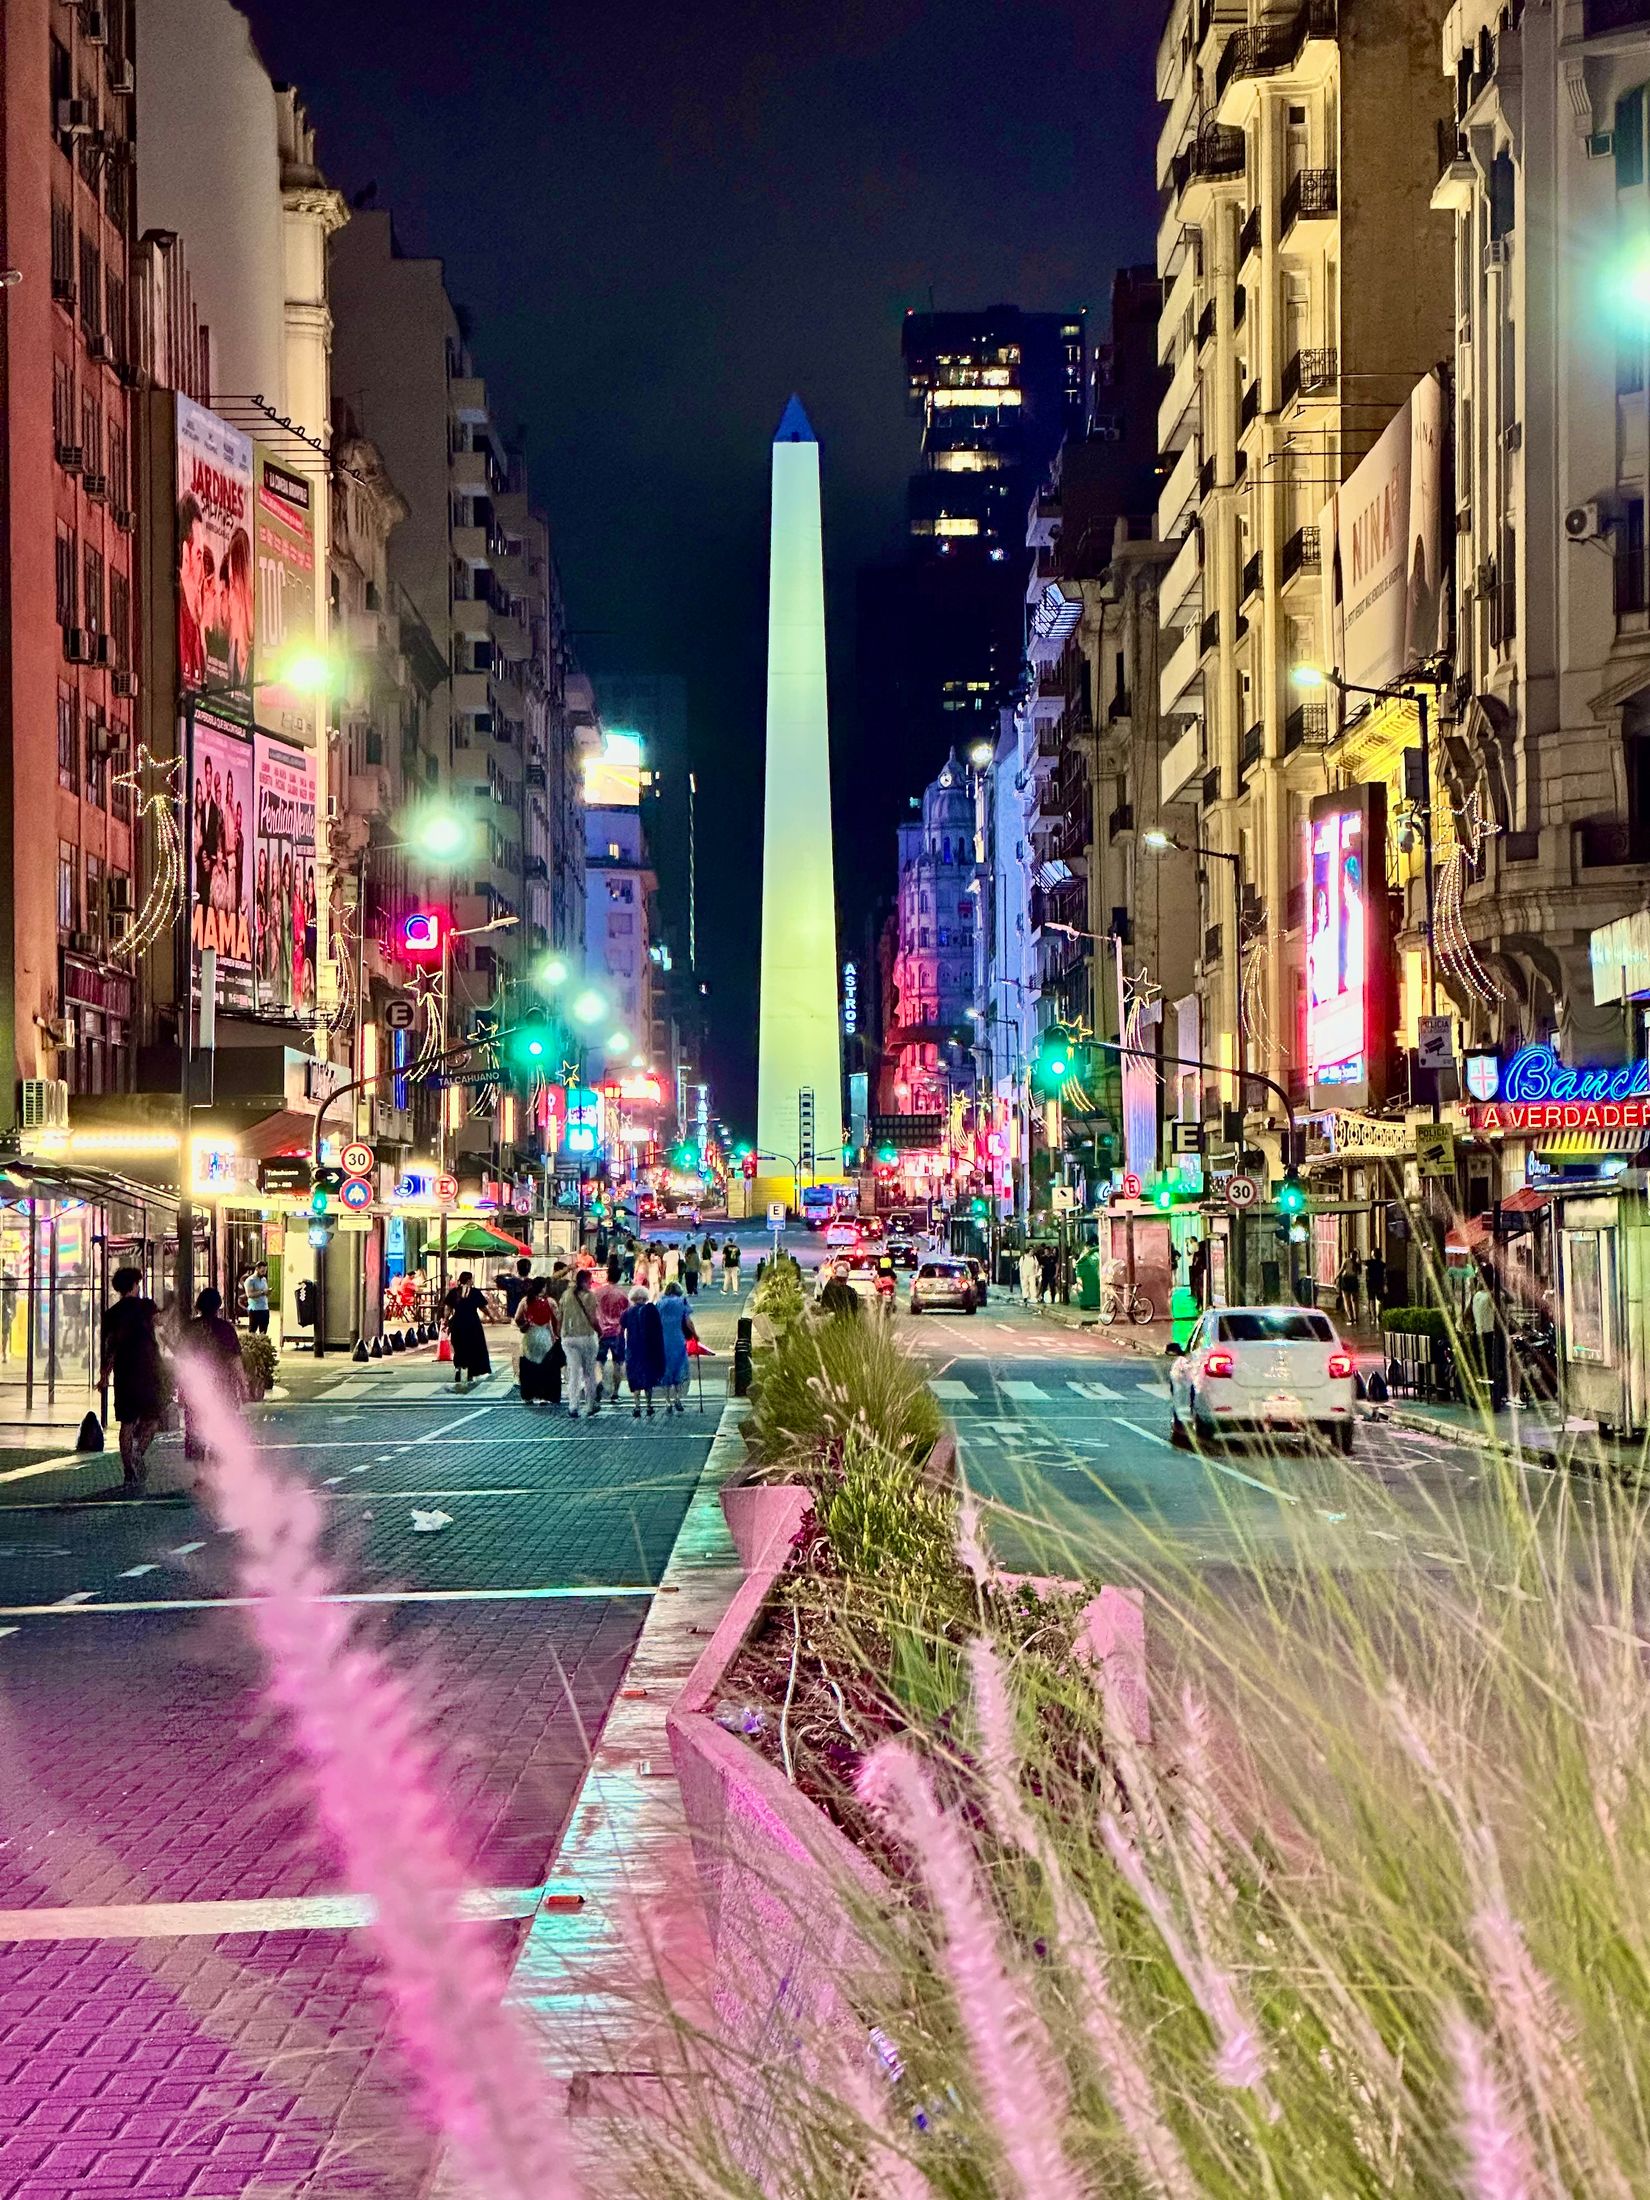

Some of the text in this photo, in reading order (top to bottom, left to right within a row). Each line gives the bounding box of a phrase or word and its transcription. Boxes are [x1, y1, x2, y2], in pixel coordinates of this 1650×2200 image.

[191, 455, 244, 520] JARDINES
[1352, 483, 1393, 588] NINA
[259, 555, 287, 646] TOC
[844, 963, 857, 1034] ASTROS
[391, 1005, 409, 1025] E
[438, 1071, 500, 1087] TALCAHUANO
[1177, 1126, 1199, 1151] E
[348, 1153, 366, 1166] 30
[1129, 1180, 1136, 1194] E
[1232, 1185, 1251, 1199] 30
[773, 1205, 780, 1216] E
